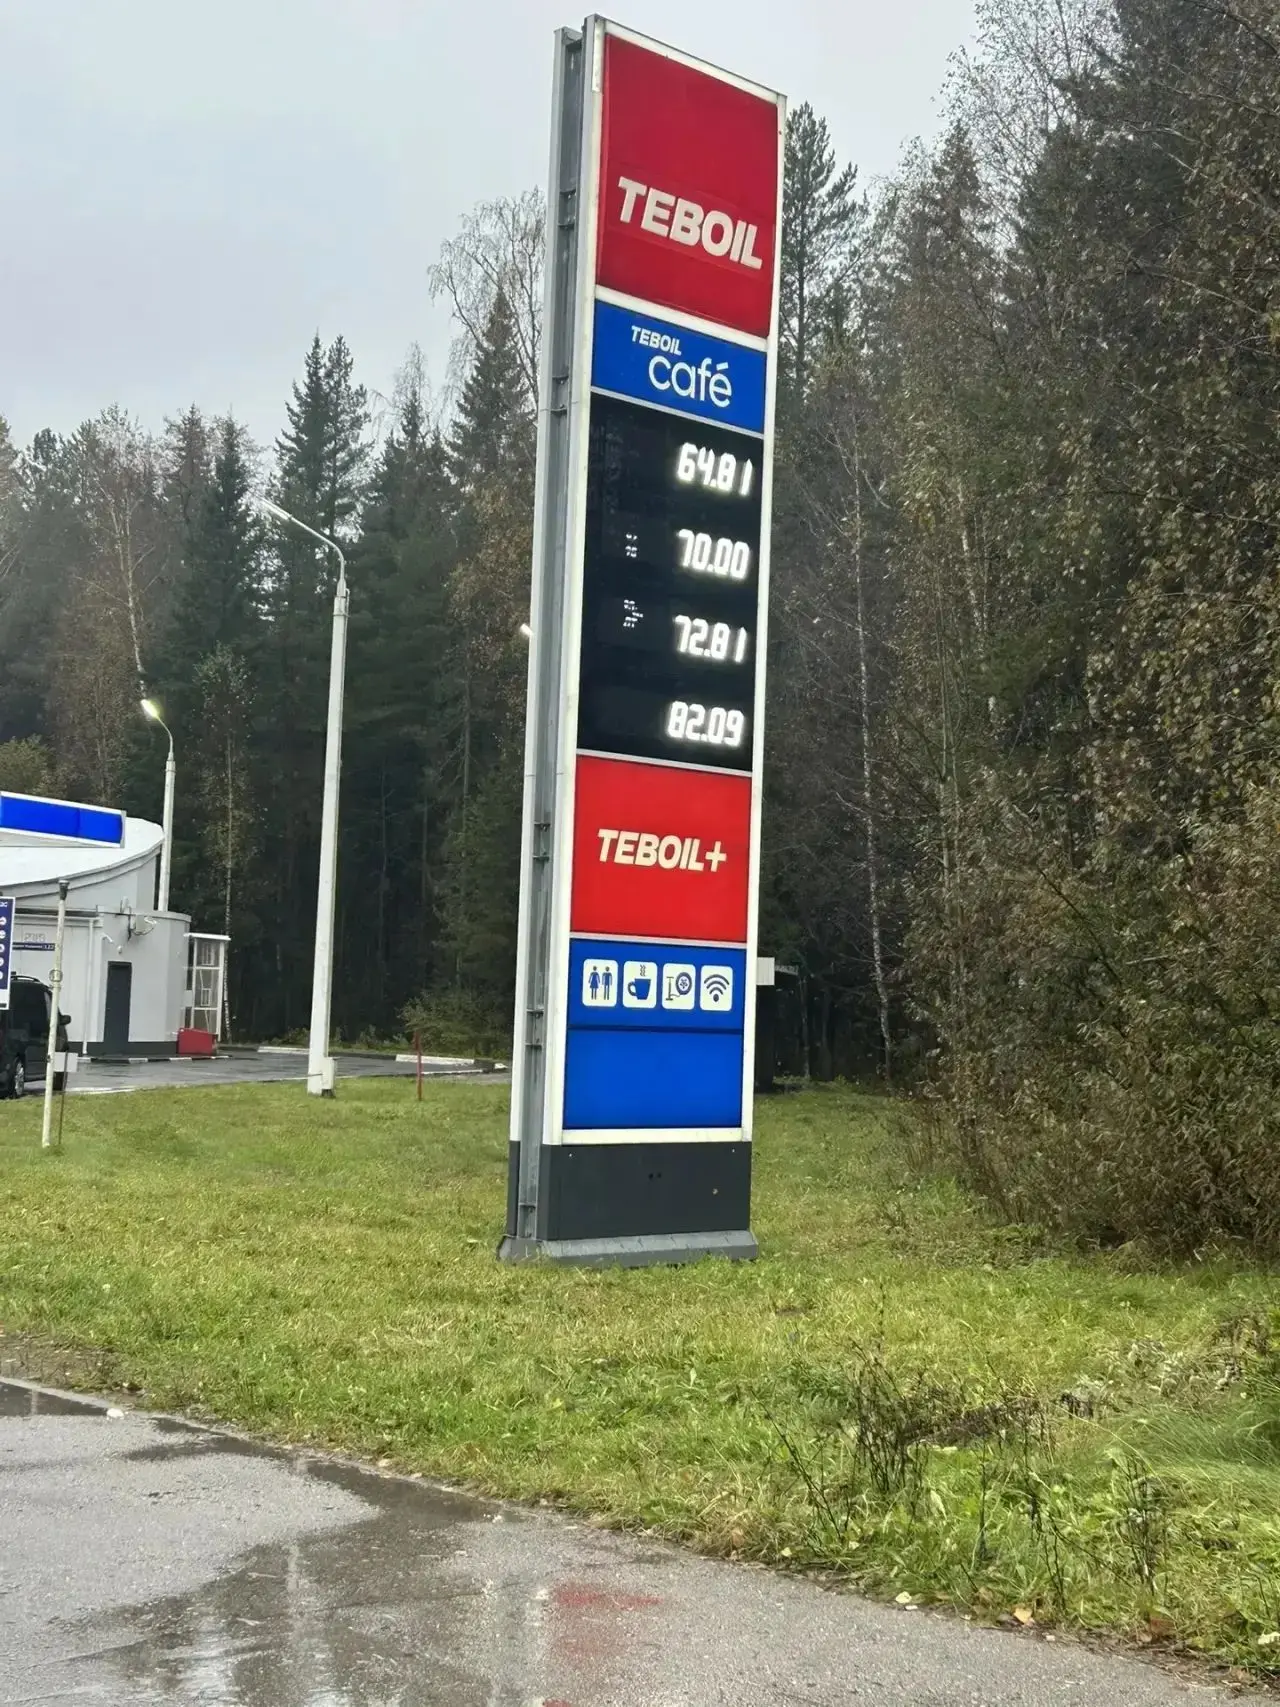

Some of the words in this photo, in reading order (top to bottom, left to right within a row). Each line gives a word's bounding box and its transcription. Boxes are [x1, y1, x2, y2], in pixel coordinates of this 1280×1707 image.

[618, 177, 762, 270] TEBOIL
[631, 325, 682, 356] TEBOIL
[648, 355, 732, 408] café
[677, 442, 753, 496] 64.81
[677, 528, 750, 580] 70.00
[674, 614, 747, 663] 72.81
[667, 701, 745, 747] 82.09
[598, 829, 727, 873] TEBOIL+
